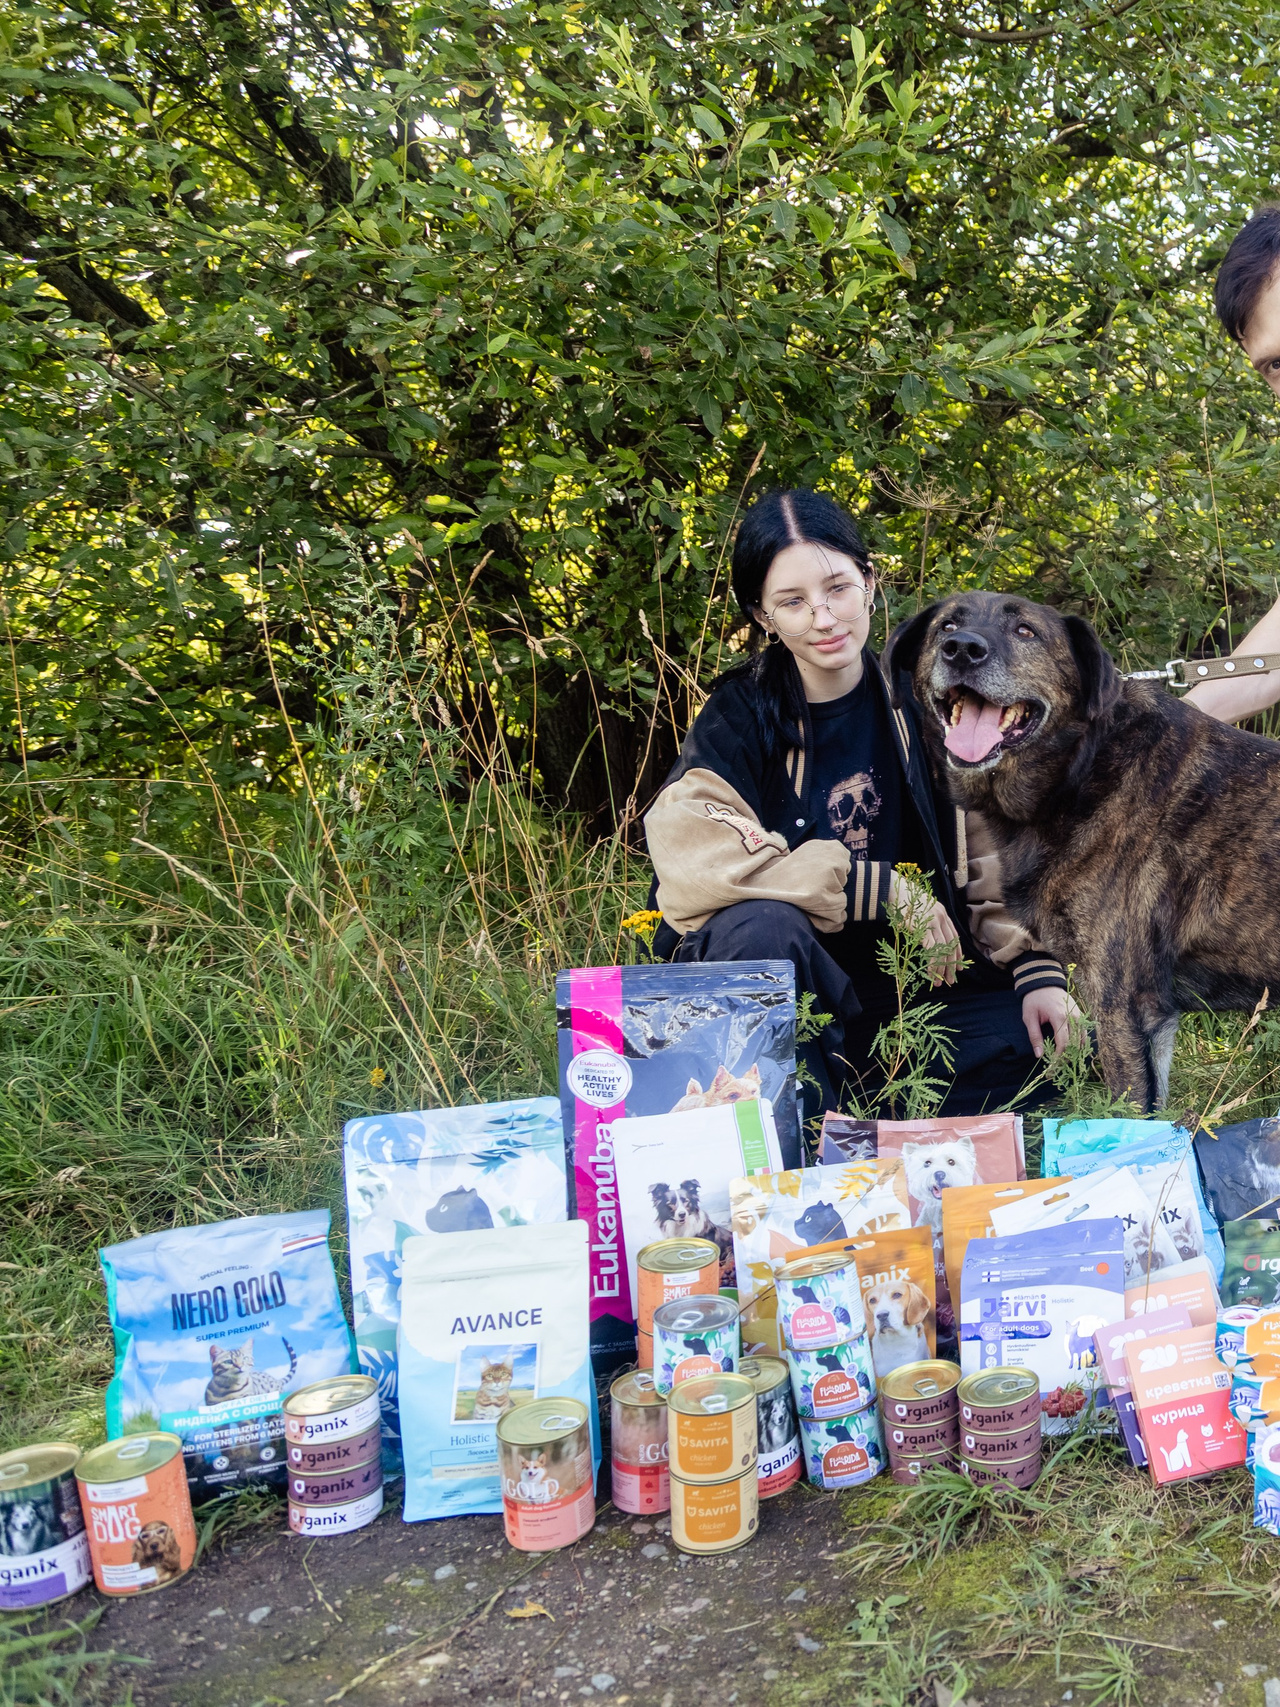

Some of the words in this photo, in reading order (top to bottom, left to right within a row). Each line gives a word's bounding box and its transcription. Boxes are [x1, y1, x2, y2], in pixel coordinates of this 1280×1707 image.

[577, 1074, 622, 1084] HEALTHY
[582, 1082, 617, 1091] ACTIVE
[586, 1088, 614, 1098] LIVES
[588, 1122, 620, 1298] Eukanuba
[200, 1268, 224, 1281] SPECIAL
[224, 1264, 250, 1273] FEELING
[171, 1285, 229, 1330] NERO
[233, 1270, 286, 1318] GOLD
[663, 1286, 692, 1299] SMART
[982, 1294, 1047, 1318] Järvi
[196, 1331, 226, 1342] SUPER
[228, 1320, 270, 1337] PREMIUM
[450, 1308, 542, 1335] AVANCE
[796, 1315, 827, 1329] FLORIDA
[999, 1324, 1019, 1332] adult
[1020, 1324, 1040, 1333] dogs
[820, 1381, 851, 1397] FLORIDA
[1146, 1375, 1212, 1400] креветка
[174, 1412, 230, 1427] ИНДЕЙКА
[232, 1408, 240, 1417] С
[894, 1400, 950, 1422] Organix
[962, 1406, 1014, 1427] Organix
[1152, 1404, 1205, 1427] курица
[194, 1433, 212, 1442] FOR
[214, 1422, 261, 1438] STERILIZED
[262, 1418, 284, 1429] CATS
[289, 1417, 348, 1438] Organix
[196, 1437, 233, 1450] KITTENS
[234, 1433, 259, 1445] FROM
[450, 1433, 490, 1448] Holistic
[689, 1436, 729, 1448] SAVITA
[893, 1430, 947, 1448] Organix
[965, 1435, 1018, 1456] Organix
[291, 1446, 351, 1468] Organix
[690, 1454, 717, 1462] chicken
[757, 1446, 799, 1478] ganix
[830, 1452, 861, 1468] FLORIDA
[294, 1478, 354, 1499] Organix
[506, 1478, 560, 1500] GOLD
[91, 1502, 138, 1522] SMART
[291, 1509, 347, 1530] Organix
[698, 1504, 738, 1518] SAVITA
[93, 1517, 142, 1544] DOG
[698, 1522, 726, 1530] chicken
